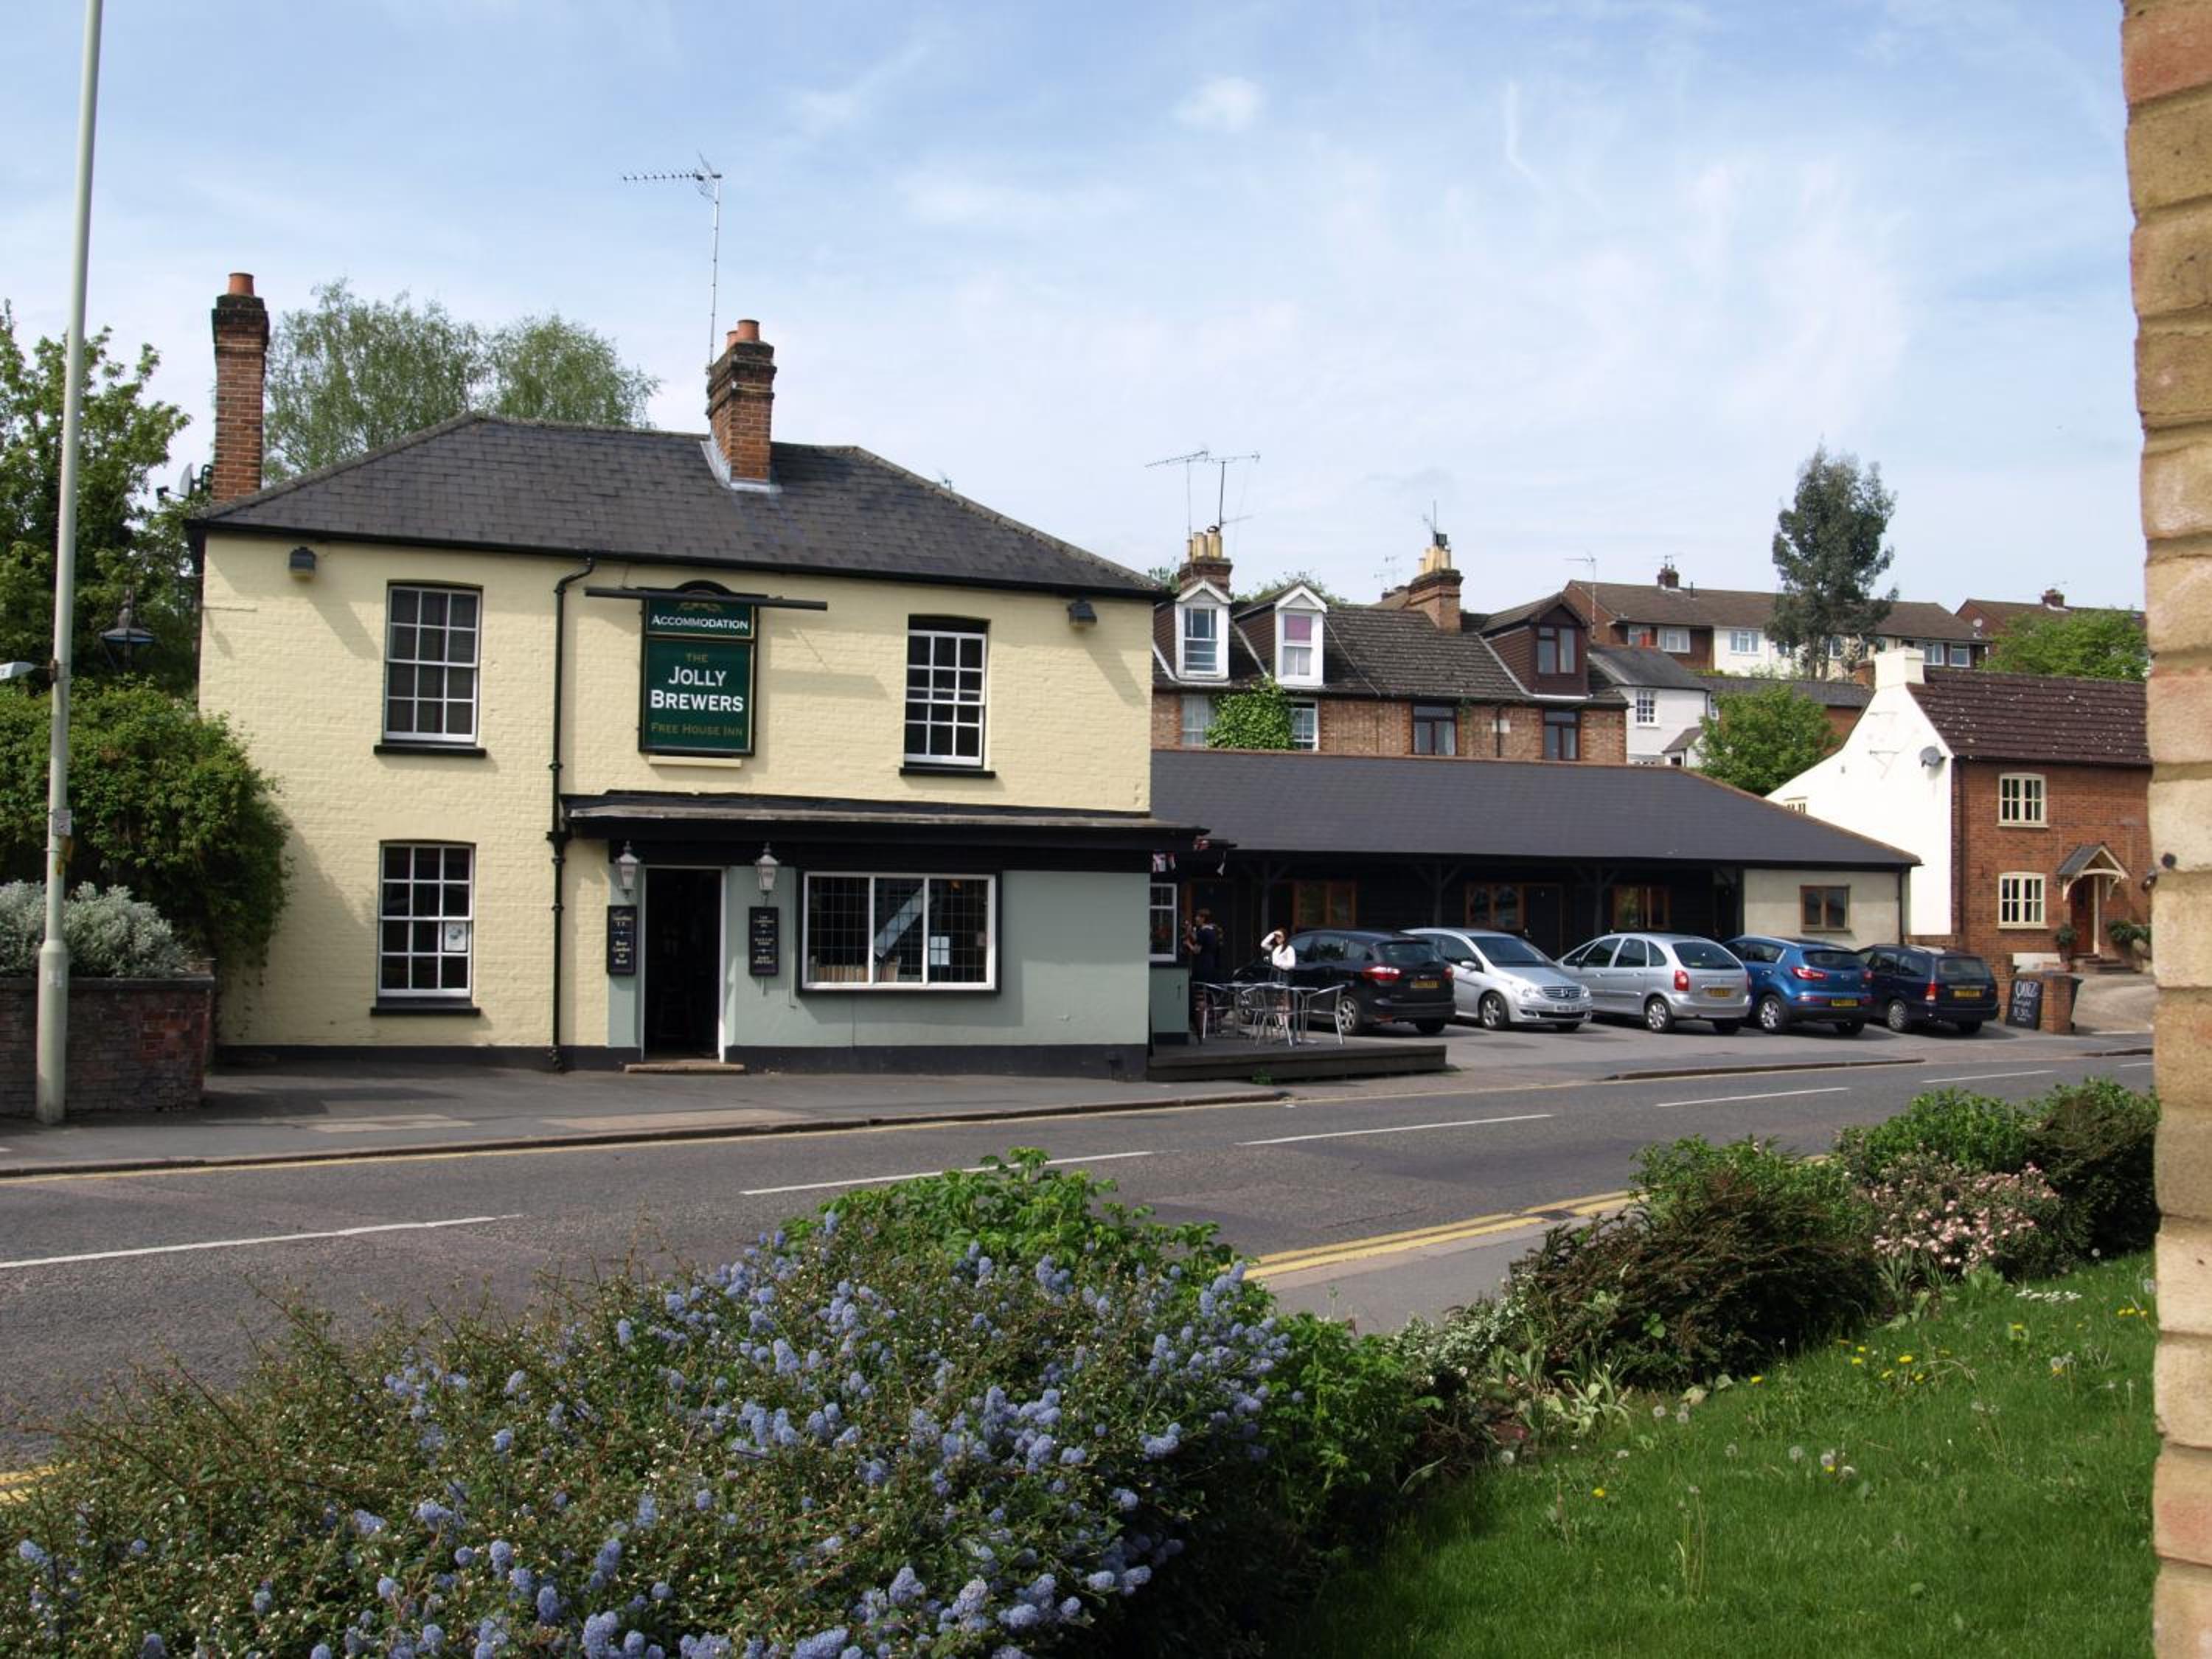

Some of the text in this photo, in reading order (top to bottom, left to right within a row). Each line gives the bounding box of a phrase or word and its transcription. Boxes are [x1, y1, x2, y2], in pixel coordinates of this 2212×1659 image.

[651, 615, 748, 630] ACCOMMODATION
[685, 653, 709, 663] THE
[667, 666, 727, 686] JOLLY
[650, 689, 744, 712] BREWERS
[651, 723, 742, 736] FREE HOUSE INN
